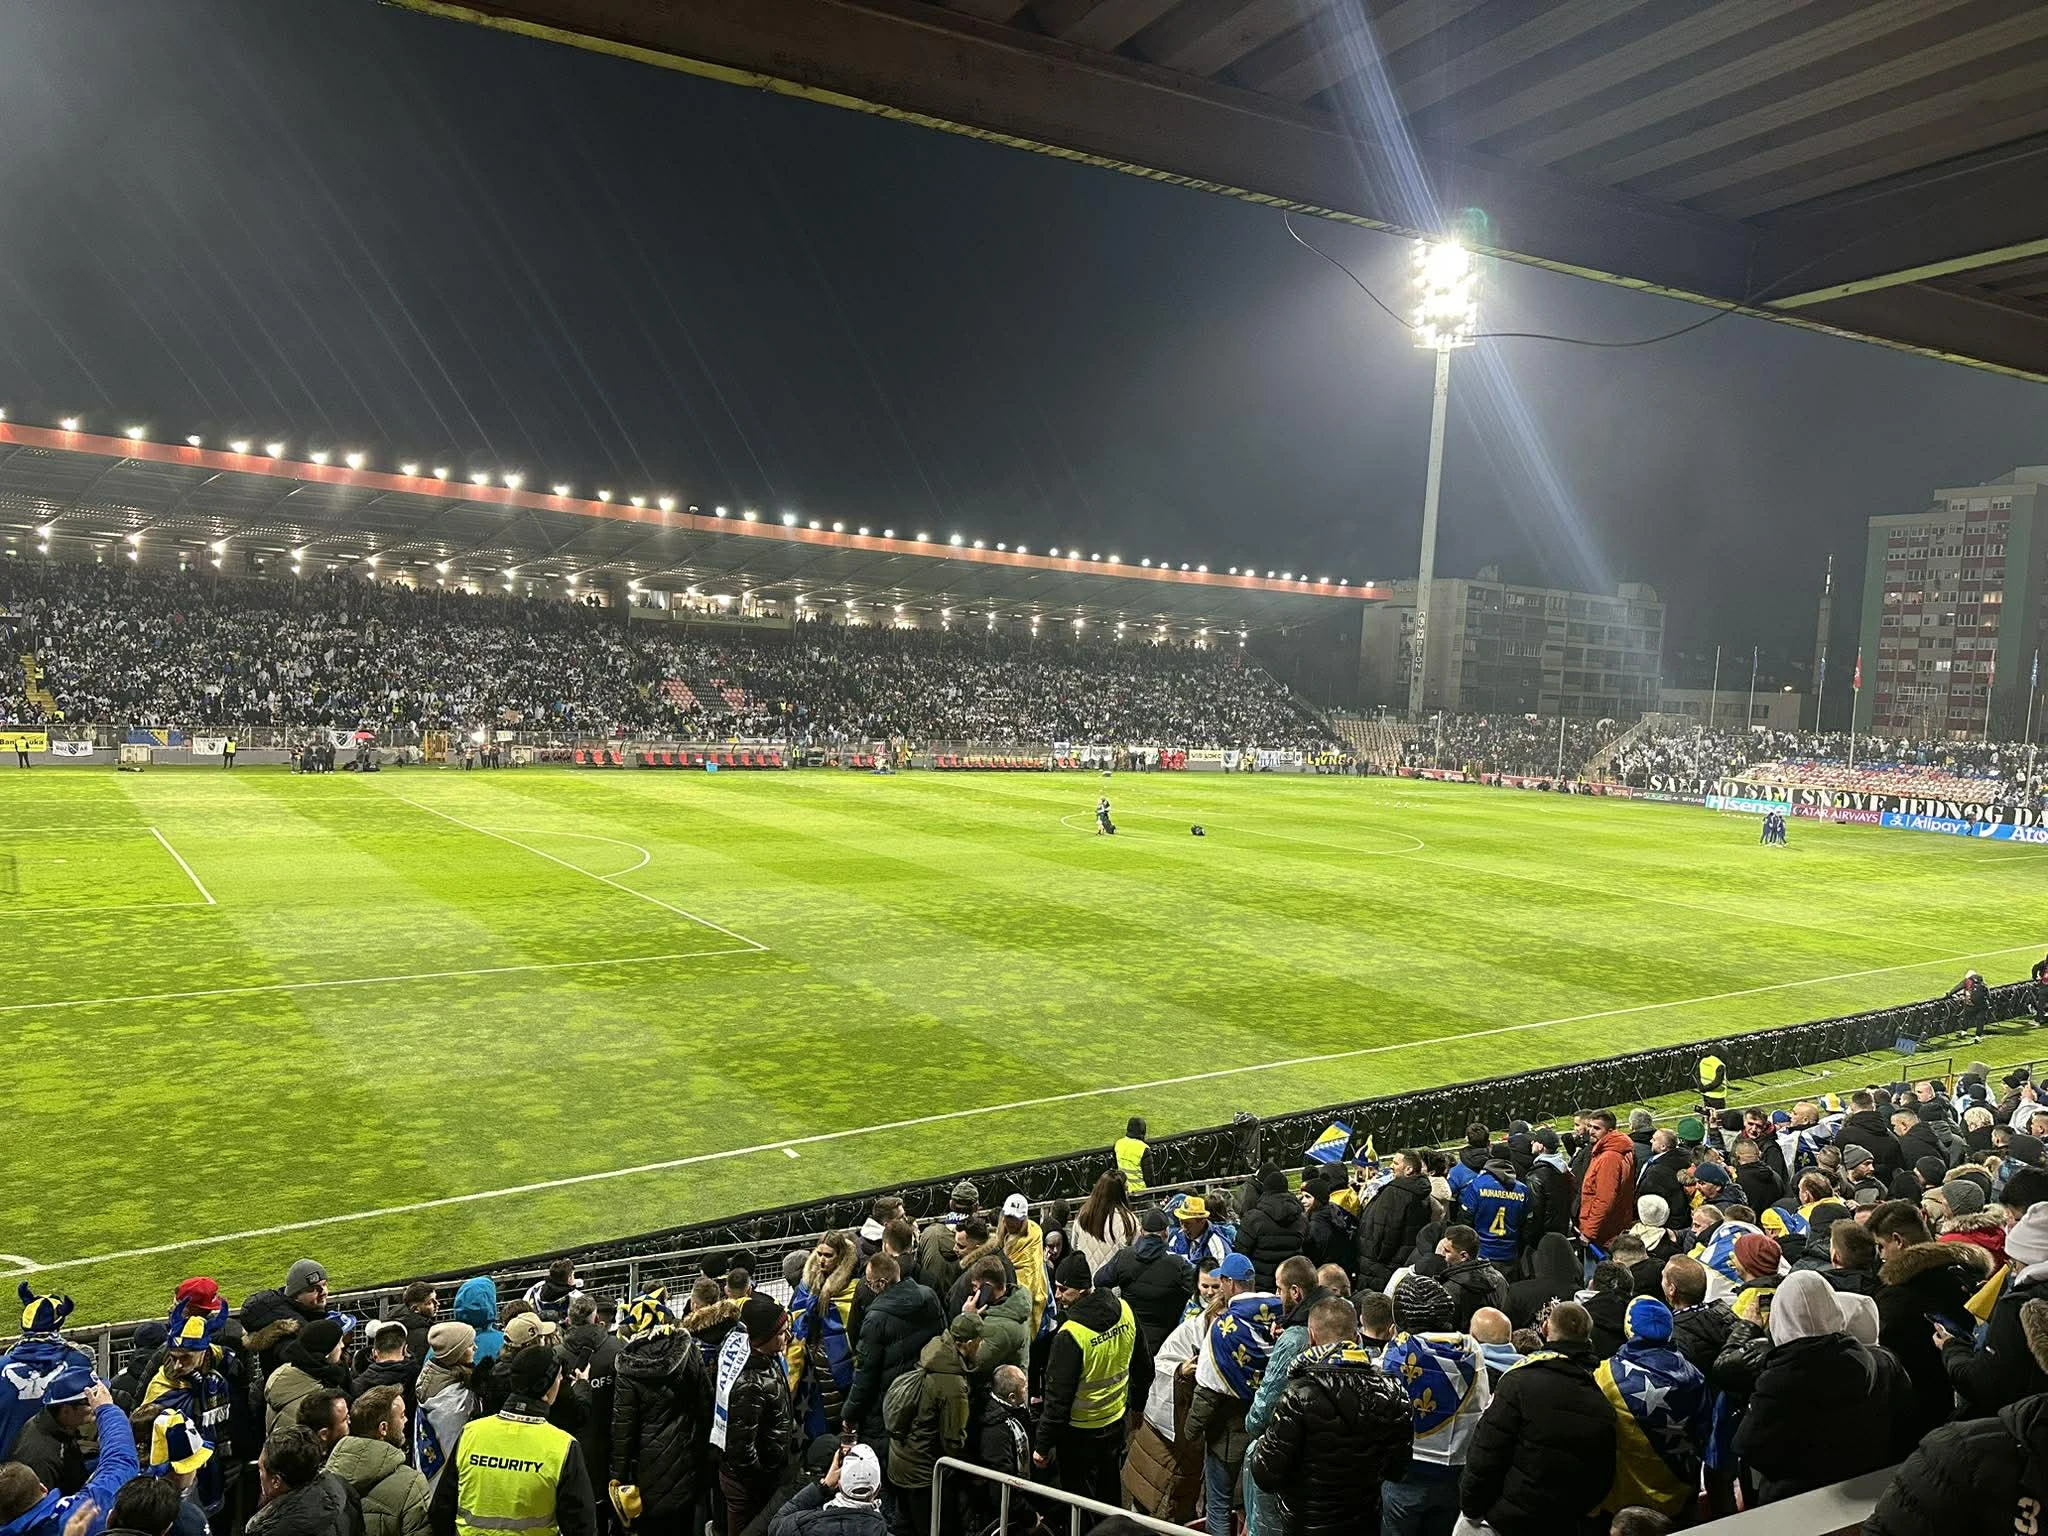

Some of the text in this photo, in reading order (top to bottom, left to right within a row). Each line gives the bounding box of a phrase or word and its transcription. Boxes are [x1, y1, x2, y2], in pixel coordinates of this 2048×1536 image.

[1743, 784, 1794, 803] SAM
[1709, 796, 1789, 815] Hisense
[1793, 807, 1879, 823] QATAR AIRWAYS
[1489, 1206, 1506, 1236] 4
[1090, 1323, 1129, 1347] SECURITY
[470, 1454, 544, 1473] SECURITY
